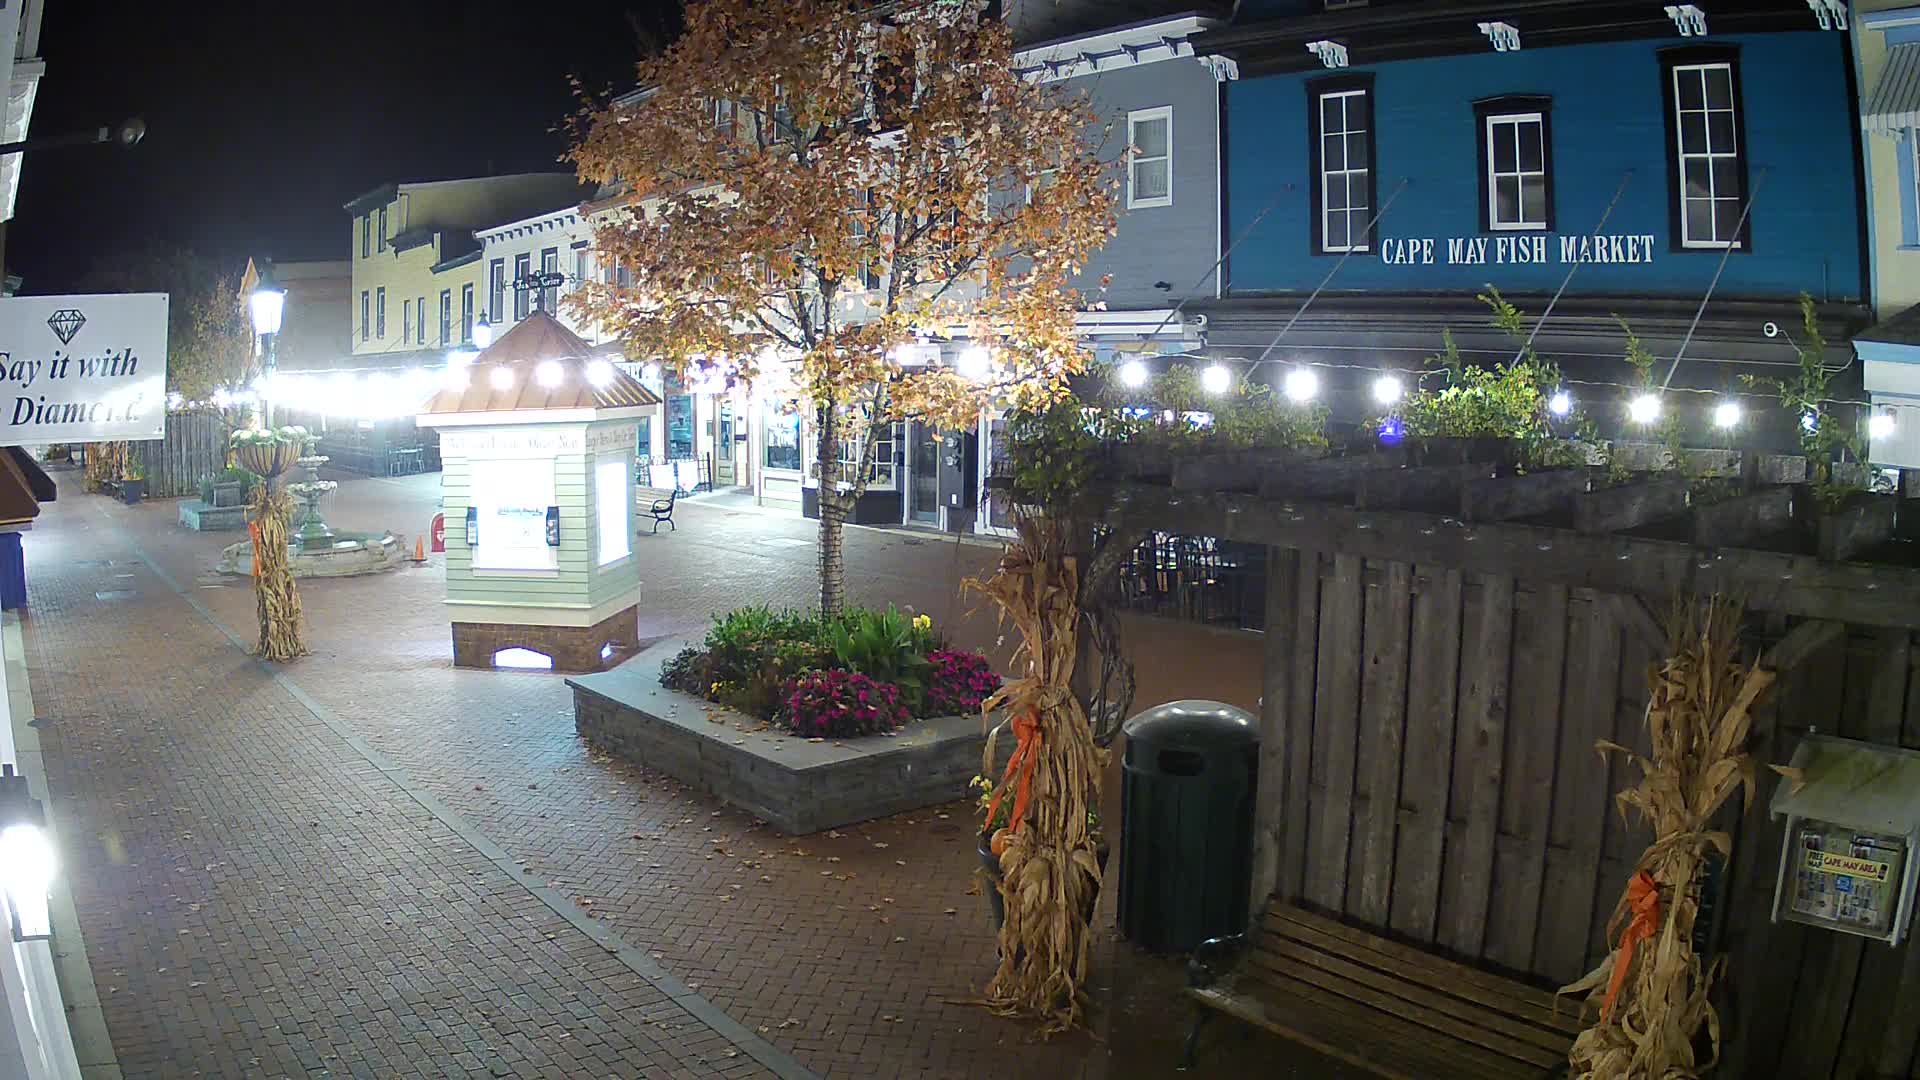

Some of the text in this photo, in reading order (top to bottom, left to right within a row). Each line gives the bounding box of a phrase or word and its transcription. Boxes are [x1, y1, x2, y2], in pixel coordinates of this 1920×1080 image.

[1381, 235, 1655, 264] CAPE MAY FISH MARKET
[0, 347, 138, 389] Say it with
[1809, 852, 1824, 861] FREE
[1825, 857, 1878, 874] CAPE MAY AREA
